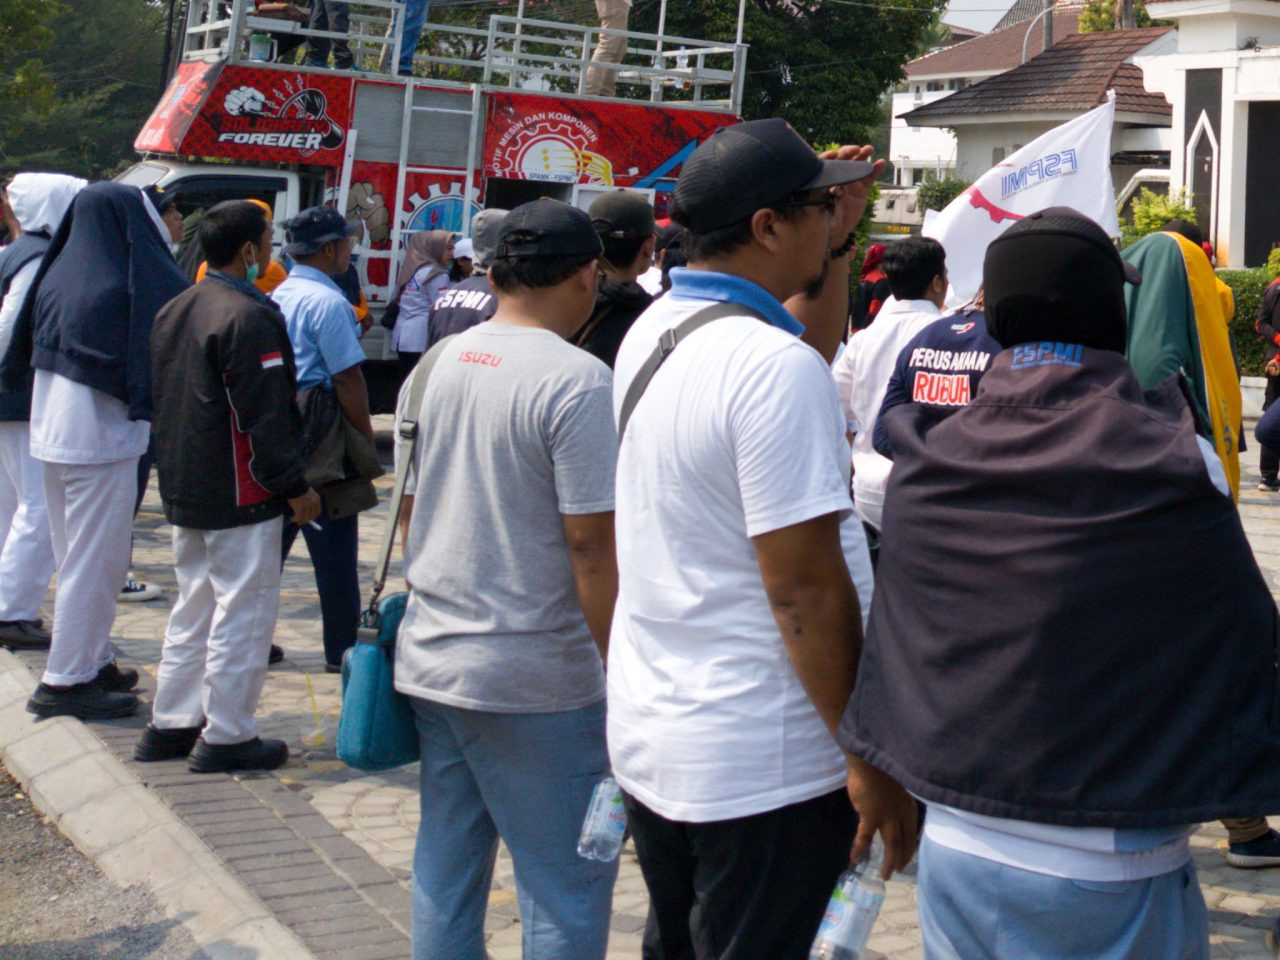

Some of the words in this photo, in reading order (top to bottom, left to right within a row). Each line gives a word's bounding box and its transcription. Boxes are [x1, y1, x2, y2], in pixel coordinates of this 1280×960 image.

[498, 121, 525, 147] MESIN
[524, 112, 546, 125] DAN
[548, 111, 598, 143] KOMPONEN
[218, 133, 323, 150] FOREVER
[434, 288, 492, 311] FSPMI
[457, 350, 503, 368] ISUZU
[1012, 342, 1084, 365] FSPMI
[913, 371, 971, 405] RUBUH
